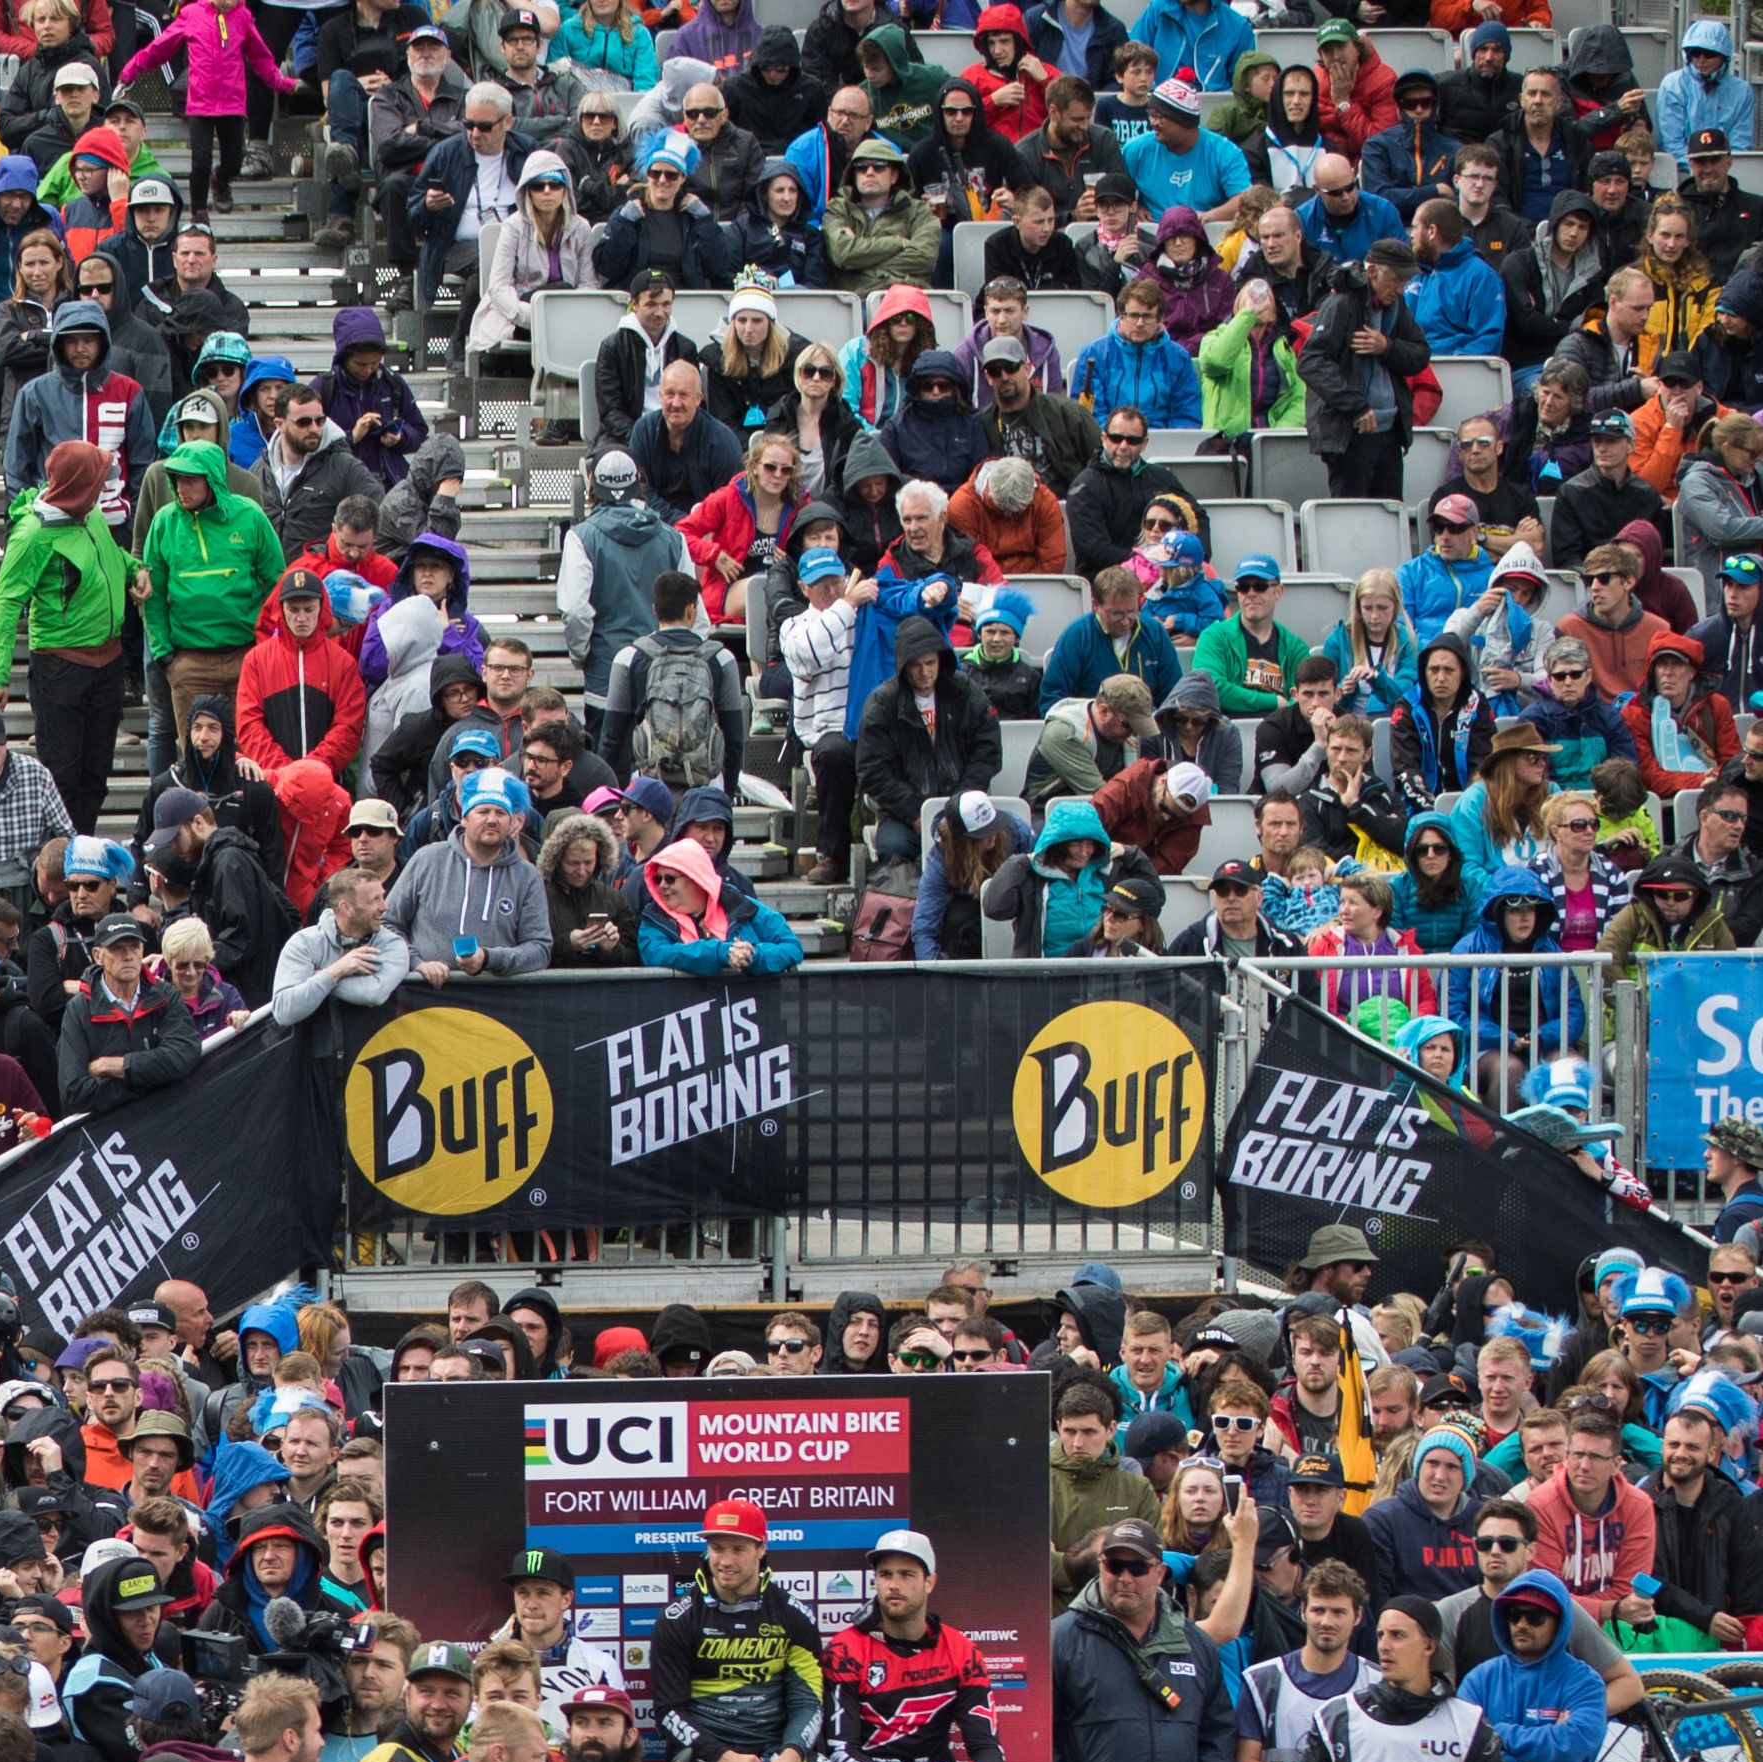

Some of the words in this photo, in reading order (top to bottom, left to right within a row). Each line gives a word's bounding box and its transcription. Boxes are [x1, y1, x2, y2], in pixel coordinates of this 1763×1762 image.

[607, 1008, 711, 1098] FLAT
[722, 996, 761, 1053] IS
[609, 1045, 791, 1166] BORING
[1257, 1070, 1380, 1140] FLAT
[1372, 1090, 1431, 1151] IS
[6, 1153, 92, 1284] FLAT
[92, 1130, 143, 1197] IS
[1231, 1132, 1433, 1214] BORING
[37, 1157, 200, 1340] BORING
[553, 1416, 673, 1465] UCI
[699, 1413, 838, 1436] MOUNTAIN
[845, 1411, 900, 1433] BIKE
[699, 1440, 793, 1463] WORLD
[798, 1440, 850, 1462] CUP
[545, 1491, 604, 1513] FORT
[610, 1488, 706, 1511] WILLIAM
[728, 1487, 802, 1509] GREAT
[810, 1486, 894, 1507] BRITAIN
[1430, 1740, 1462, 1758] UC
